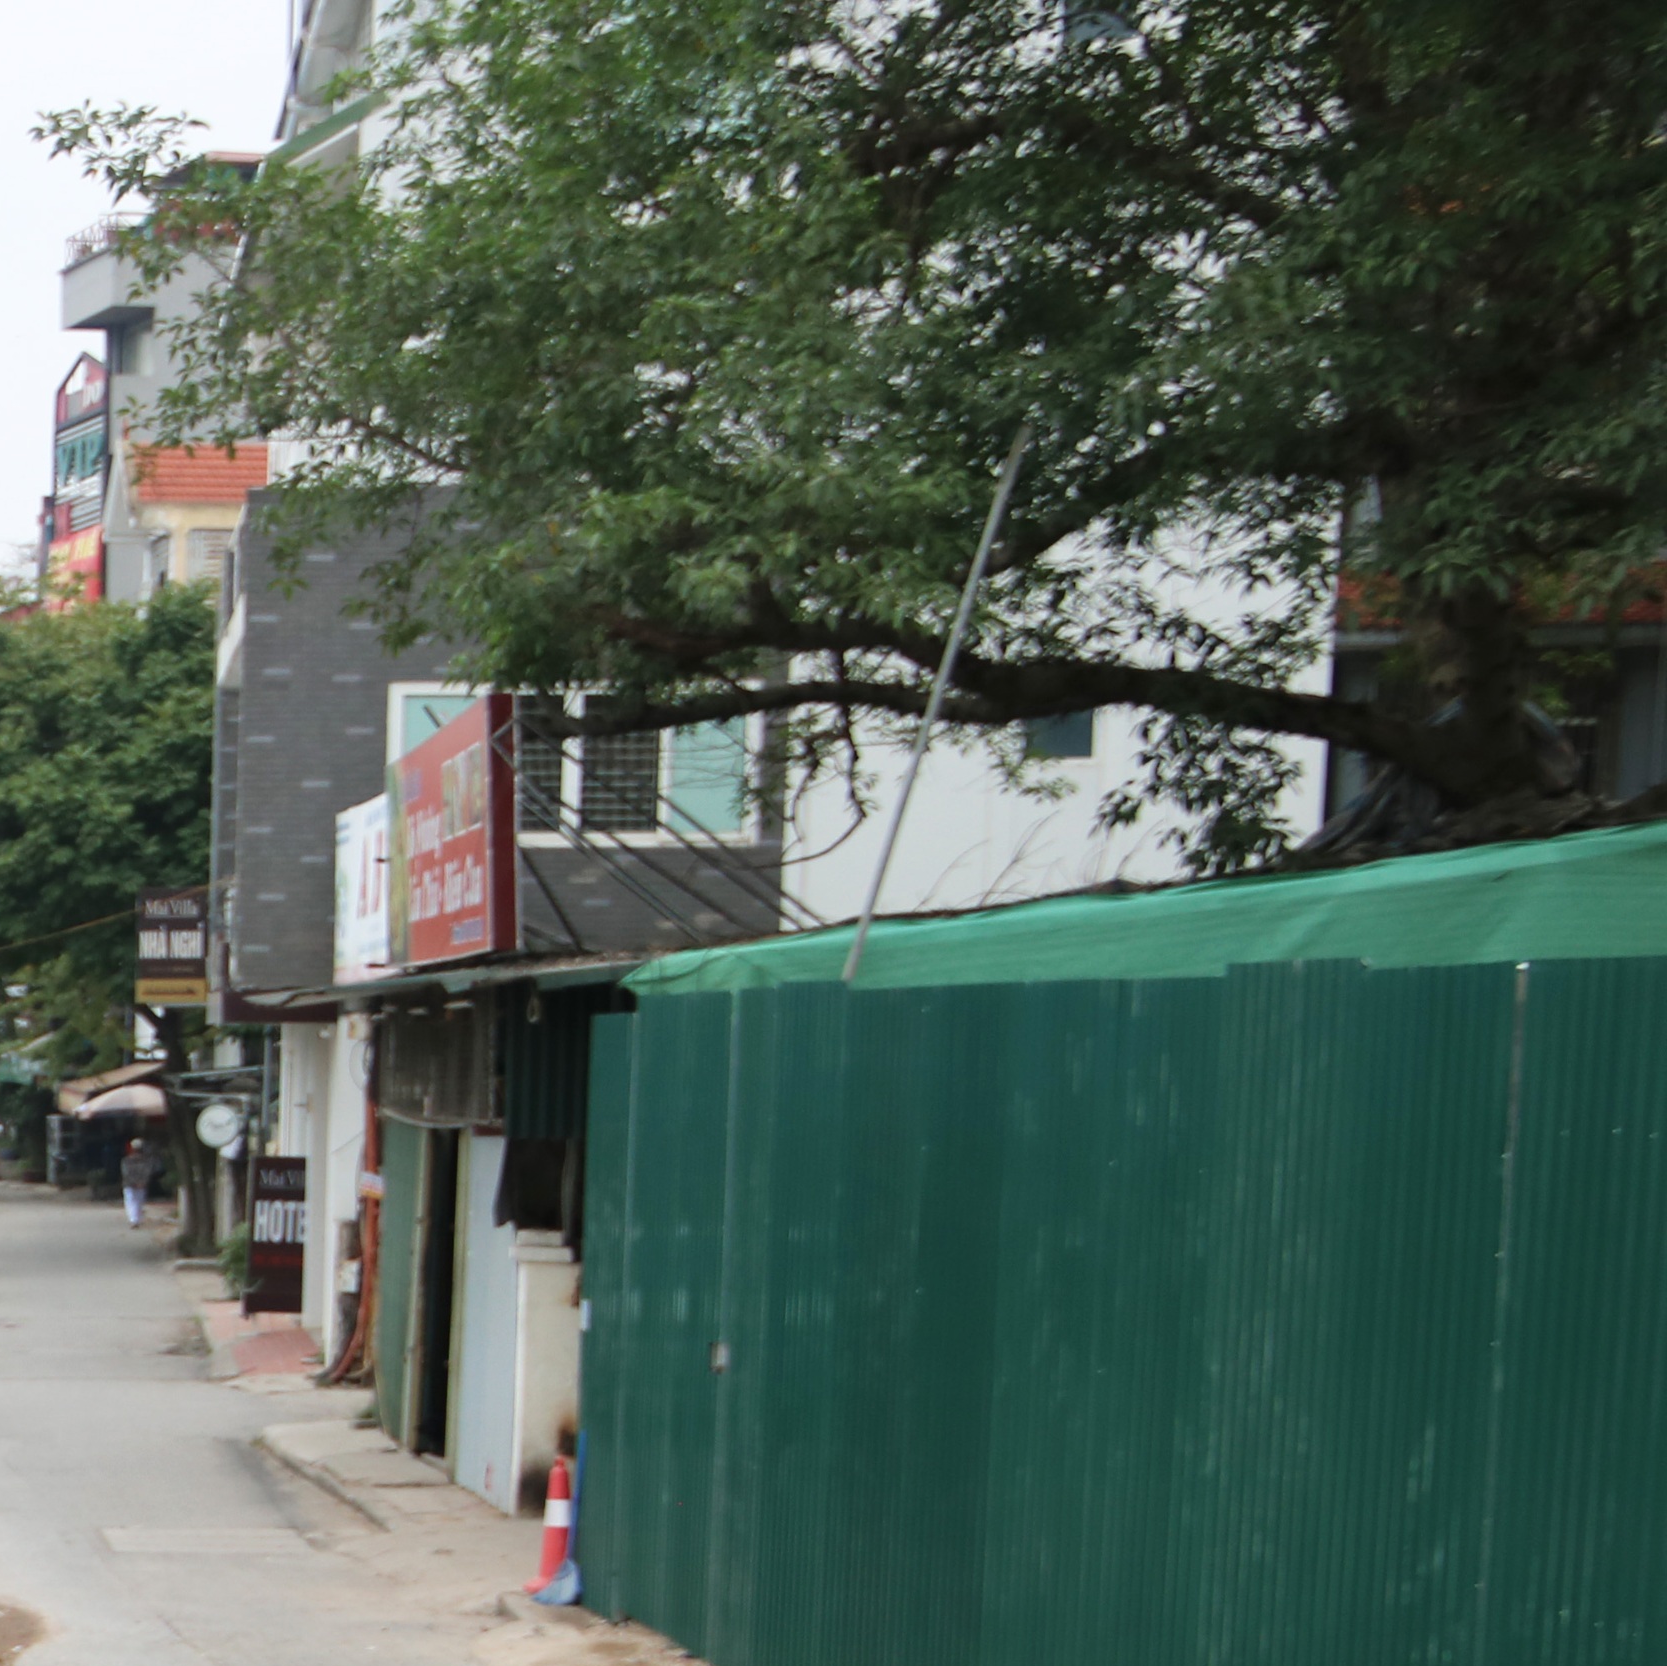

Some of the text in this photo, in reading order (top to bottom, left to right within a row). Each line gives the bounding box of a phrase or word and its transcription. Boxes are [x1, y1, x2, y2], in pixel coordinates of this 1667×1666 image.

[145, 900, 198, 916] Mai Villa
[139, 924, 167, 959] NHÀ
